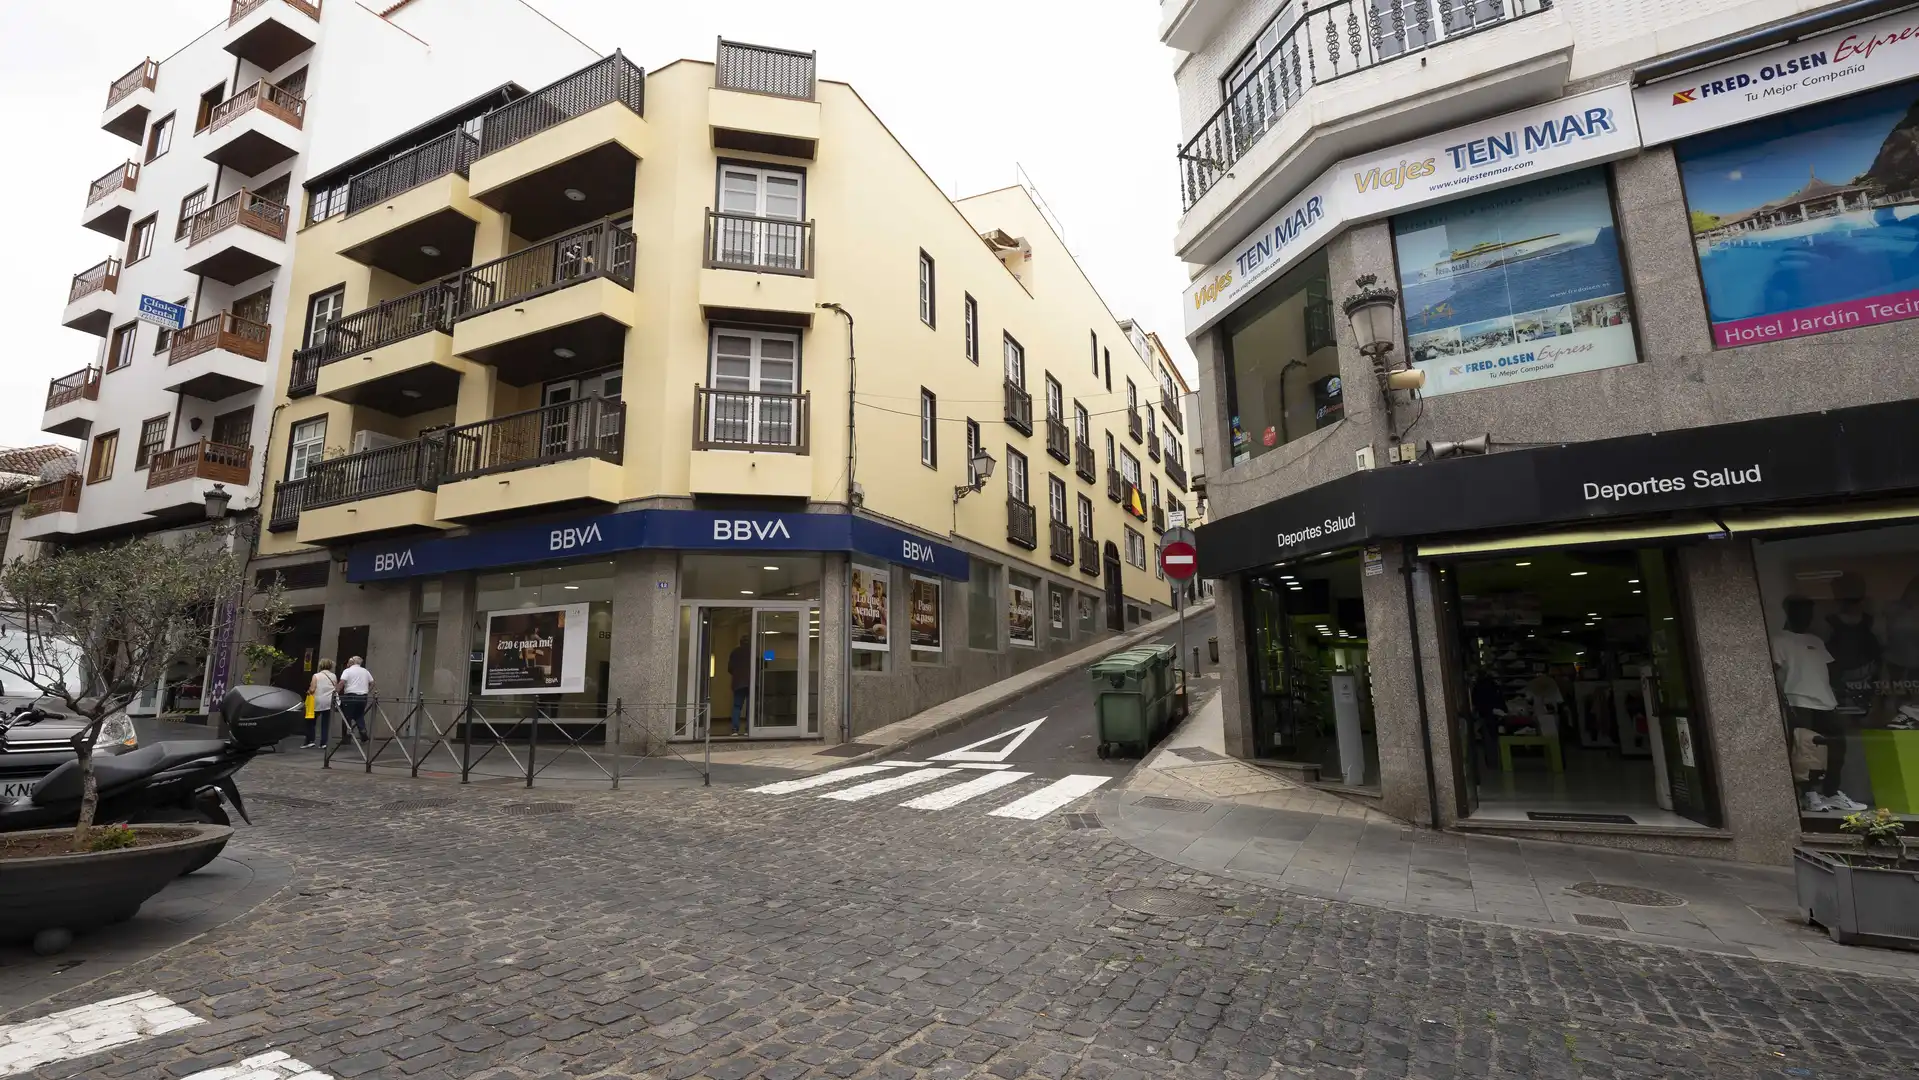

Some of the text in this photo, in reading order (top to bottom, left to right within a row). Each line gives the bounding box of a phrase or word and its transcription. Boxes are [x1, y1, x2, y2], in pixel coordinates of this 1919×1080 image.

[1700, 72, 1758, 98] FRED.
[1759, 51, 1828, 81] OLSEN
[1745, 92, 1758, 102] Tu
[1762, 82, 1798, 99] Mejor
[1354, 107, 1617, 194] Viajes TEN MAR
[1428, 160, 1534, 192] www.viajestenmar.com
[1194, 194, 1324, 310] Viajes TEN MAR
[143, 297, 178, 314] Clínica
[143, 304, 176, 320] Dental
[1724, 319, 1783, 343] Hotel
[1790, 309, 1860, 333] Jardín
[1498, 351, 1535, 366] OLSEN
[1536, 341, 1595, 361] Express
[1499, 369, 1518, 378] Mejor
[1583, 464, 1762, 501] Deportes Salud
[549, 522, 603, 551] BBVA
[713, 518, 791, 541] BBVA
[1277, 512, 1356, 548] Deportes Salud
[374, 549, 414, 572] BBVA
[903, 539, 935, 563] BBVA
[918, 599, 932, 612] Paso
[519, 638, 538, 652] para
[4, 782, 36, 797] KN
